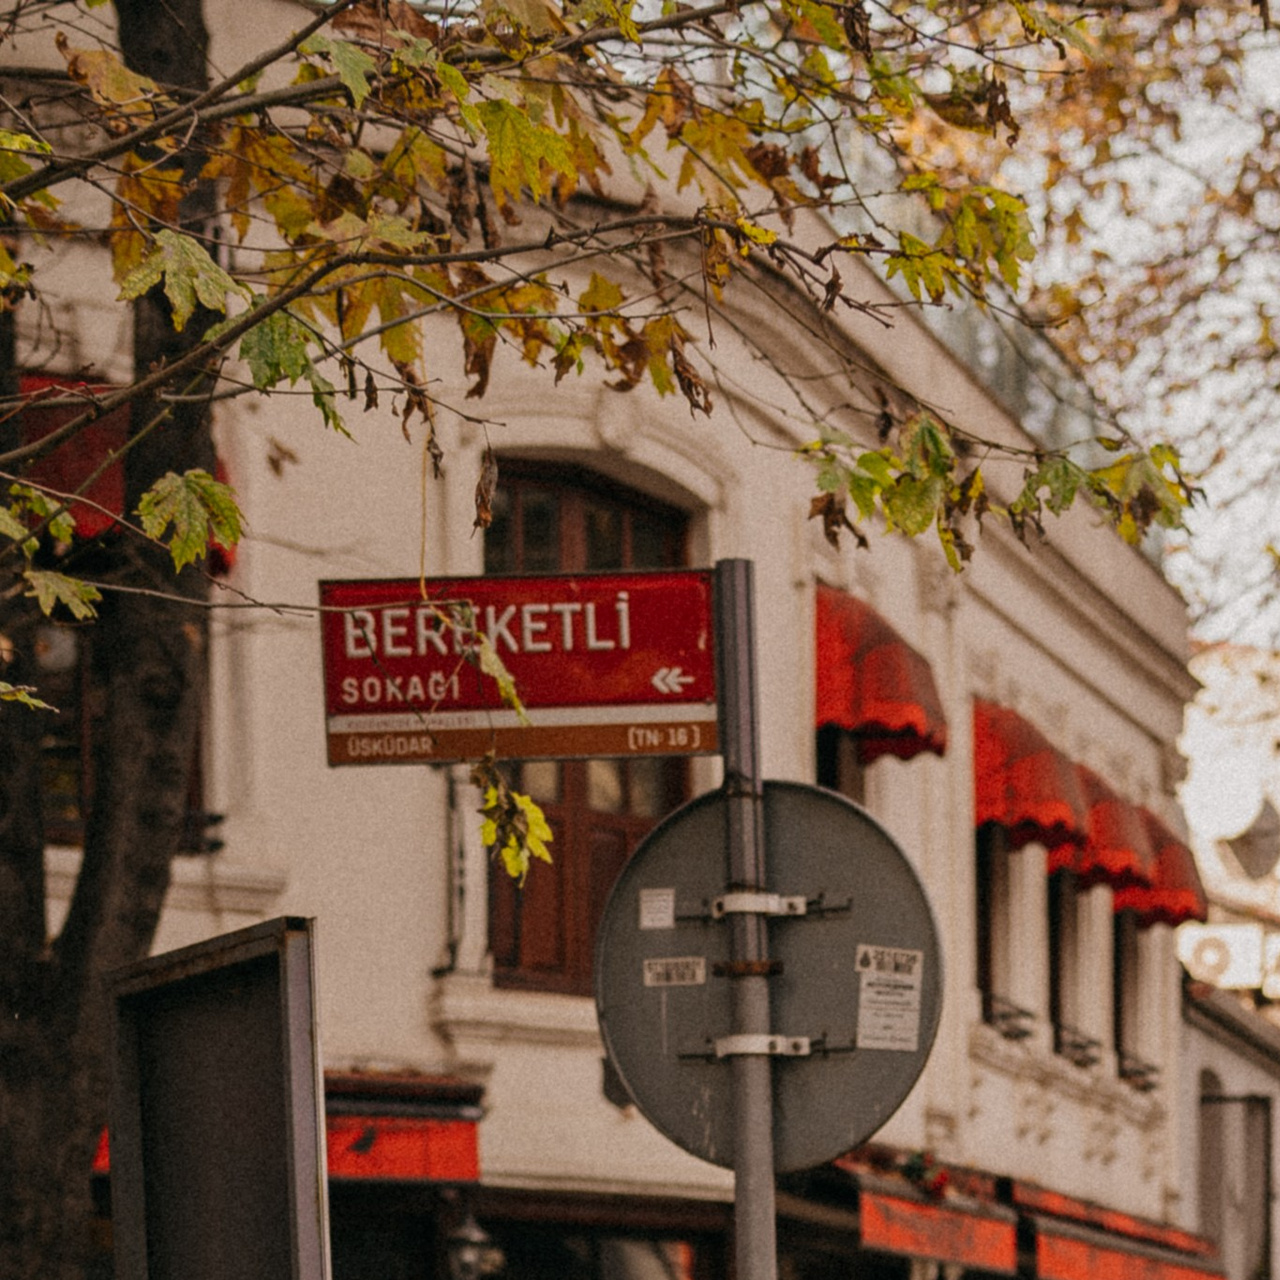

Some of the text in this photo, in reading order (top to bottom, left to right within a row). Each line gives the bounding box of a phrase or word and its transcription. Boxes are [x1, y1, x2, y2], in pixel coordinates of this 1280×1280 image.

[344, 591, 631, 658] BEREKETLİ
[341, 670, 460, 704] SOKAĞI
[347, 735, 433, 757] ÜSKÜDAR
